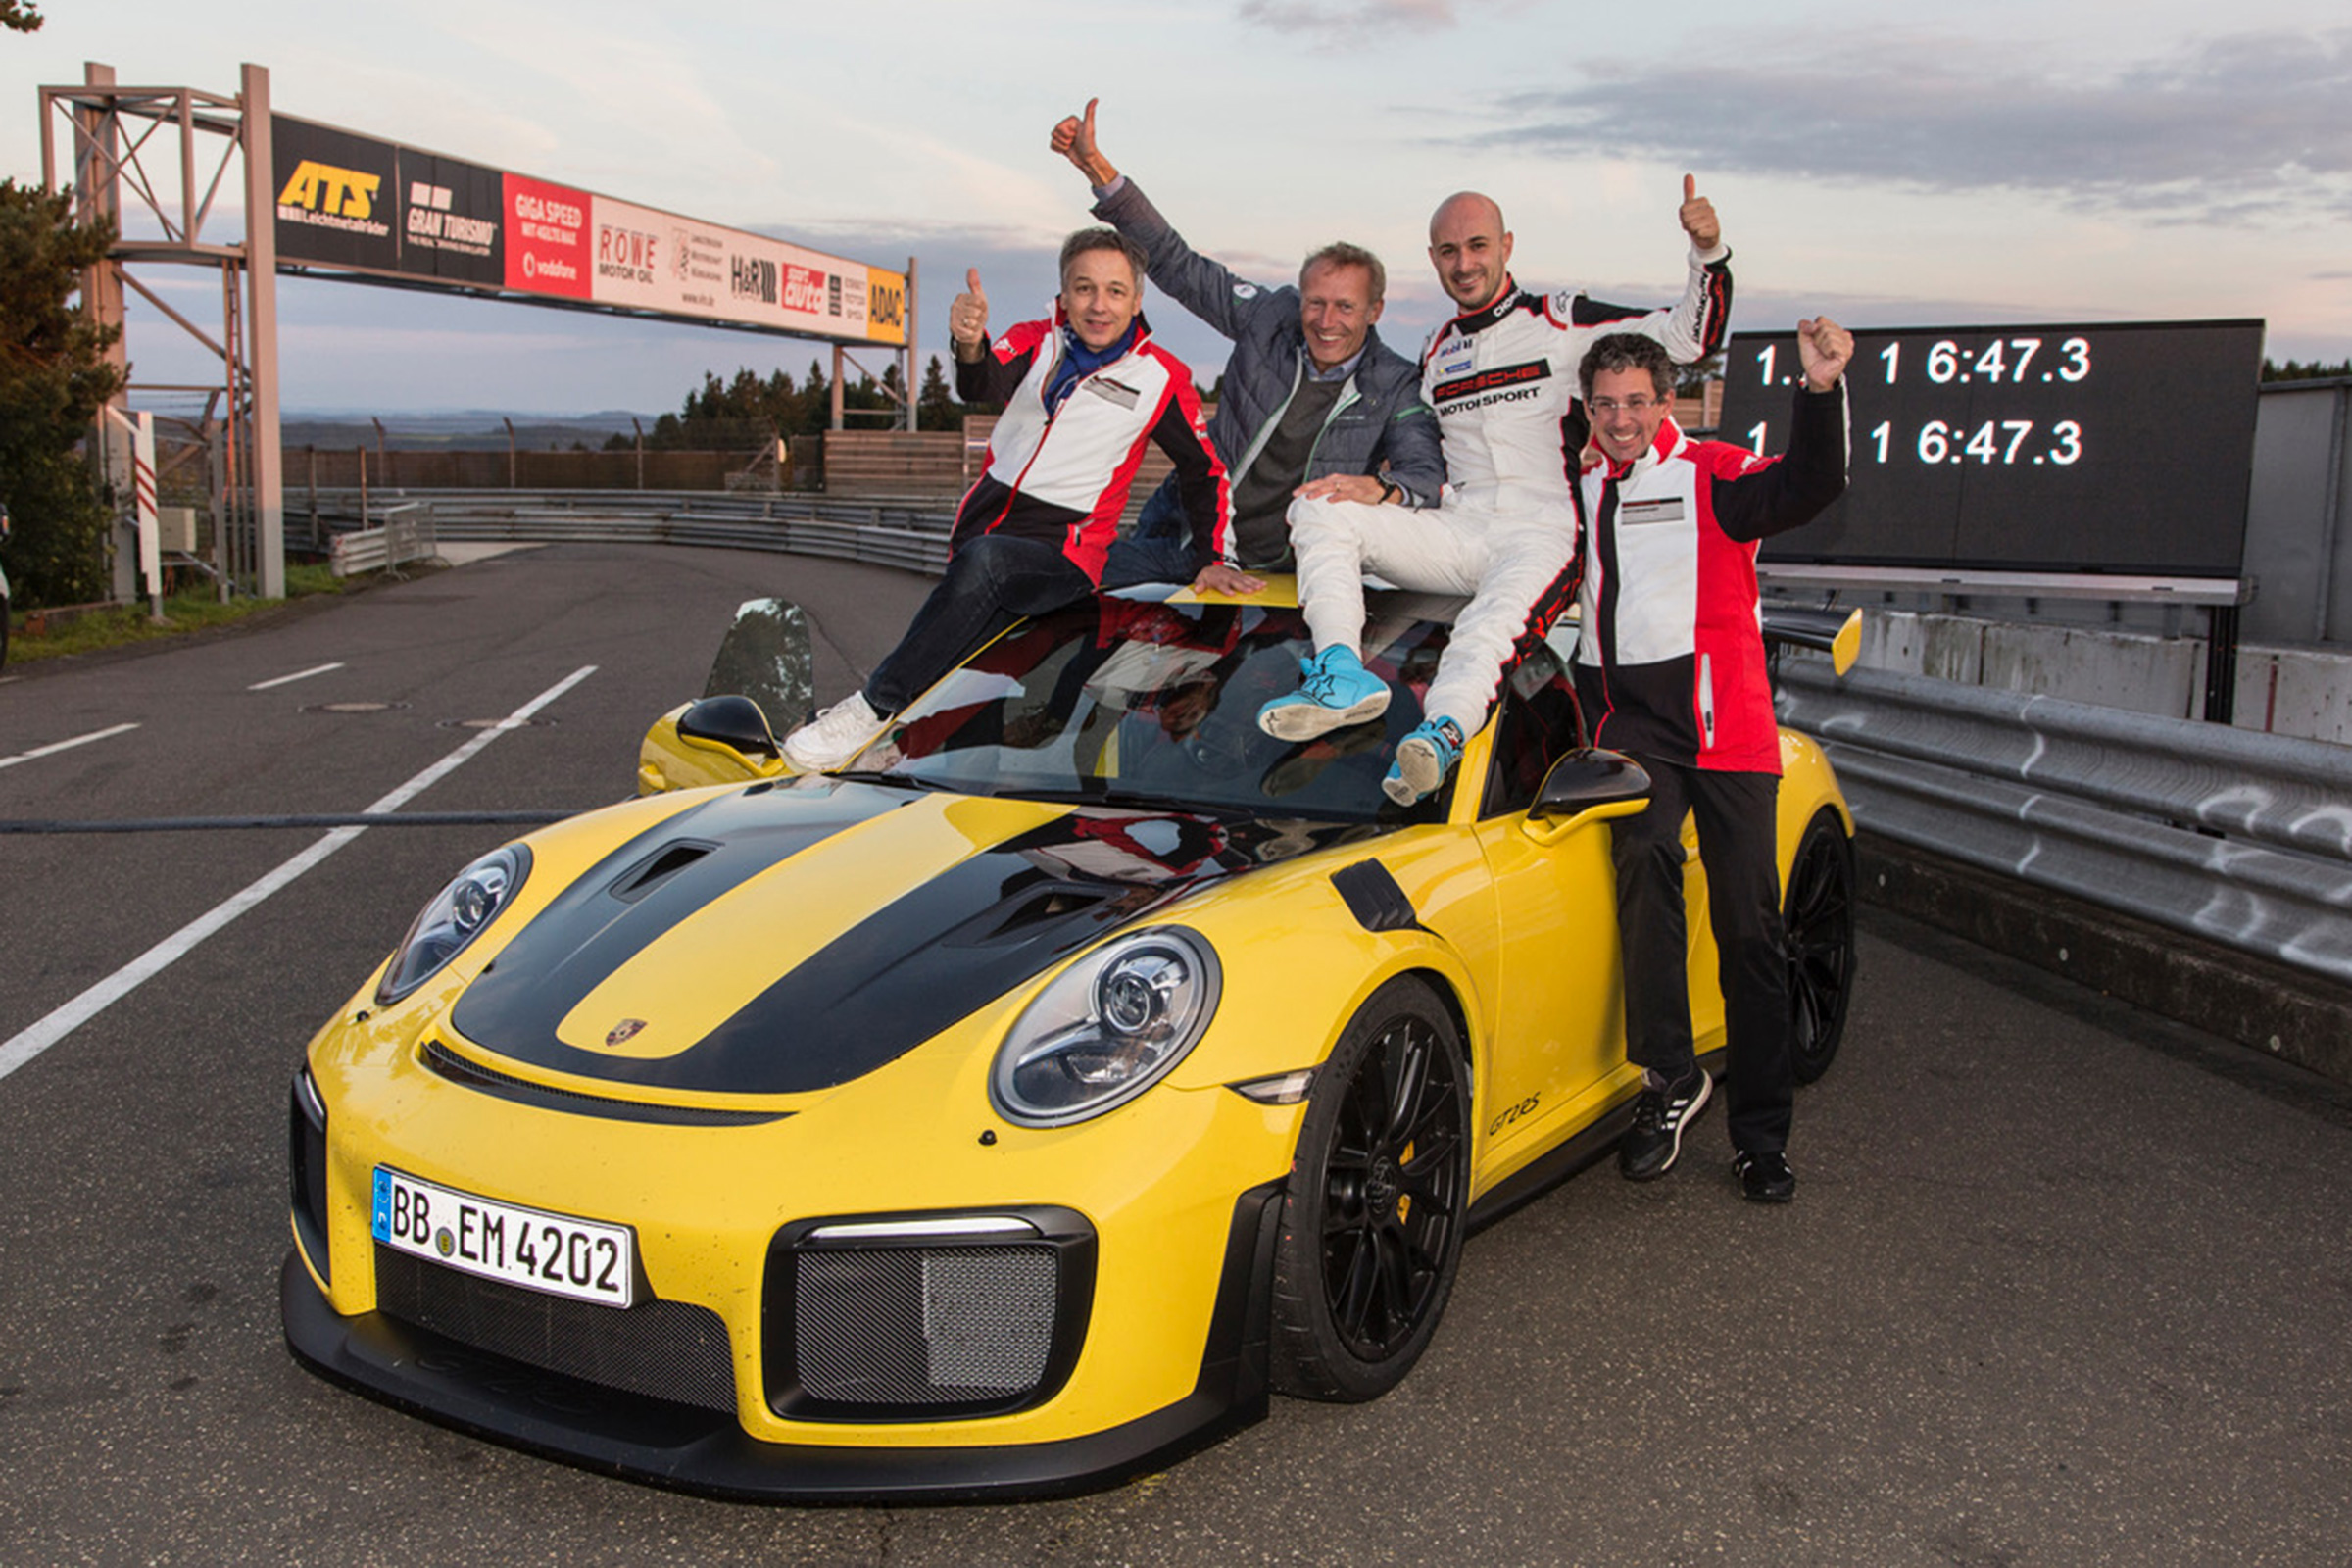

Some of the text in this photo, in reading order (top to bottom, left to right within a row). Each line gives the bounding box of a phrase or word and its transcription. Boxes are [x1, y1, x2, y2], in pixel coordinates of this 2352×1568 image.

[277, 159, 381, 220] ATS
[407, 207, 494, 246] GRAN TURISMO
[515, 193, 582, 229] GIGA SPEED
[599, 227, 656, 270] ROWE
[537, 259, 577, 281] vodafone
[599, 263, 654, 284] MOTOR OIL
[731, 253, 760, 295] H&R
[785, 282, 823, 311] auto
[869, 283, 903, 327] ADAC
[1436, 365, 1541, 398] PORSCHE
[1756, 336, 2092, 386] 1. 1 6:47.3
[1870, 419, 1891, 464] 1
[1916, 418, 2083, 465] 6:47.3
[394, 1184, 619, 1293] BB EM 4202
